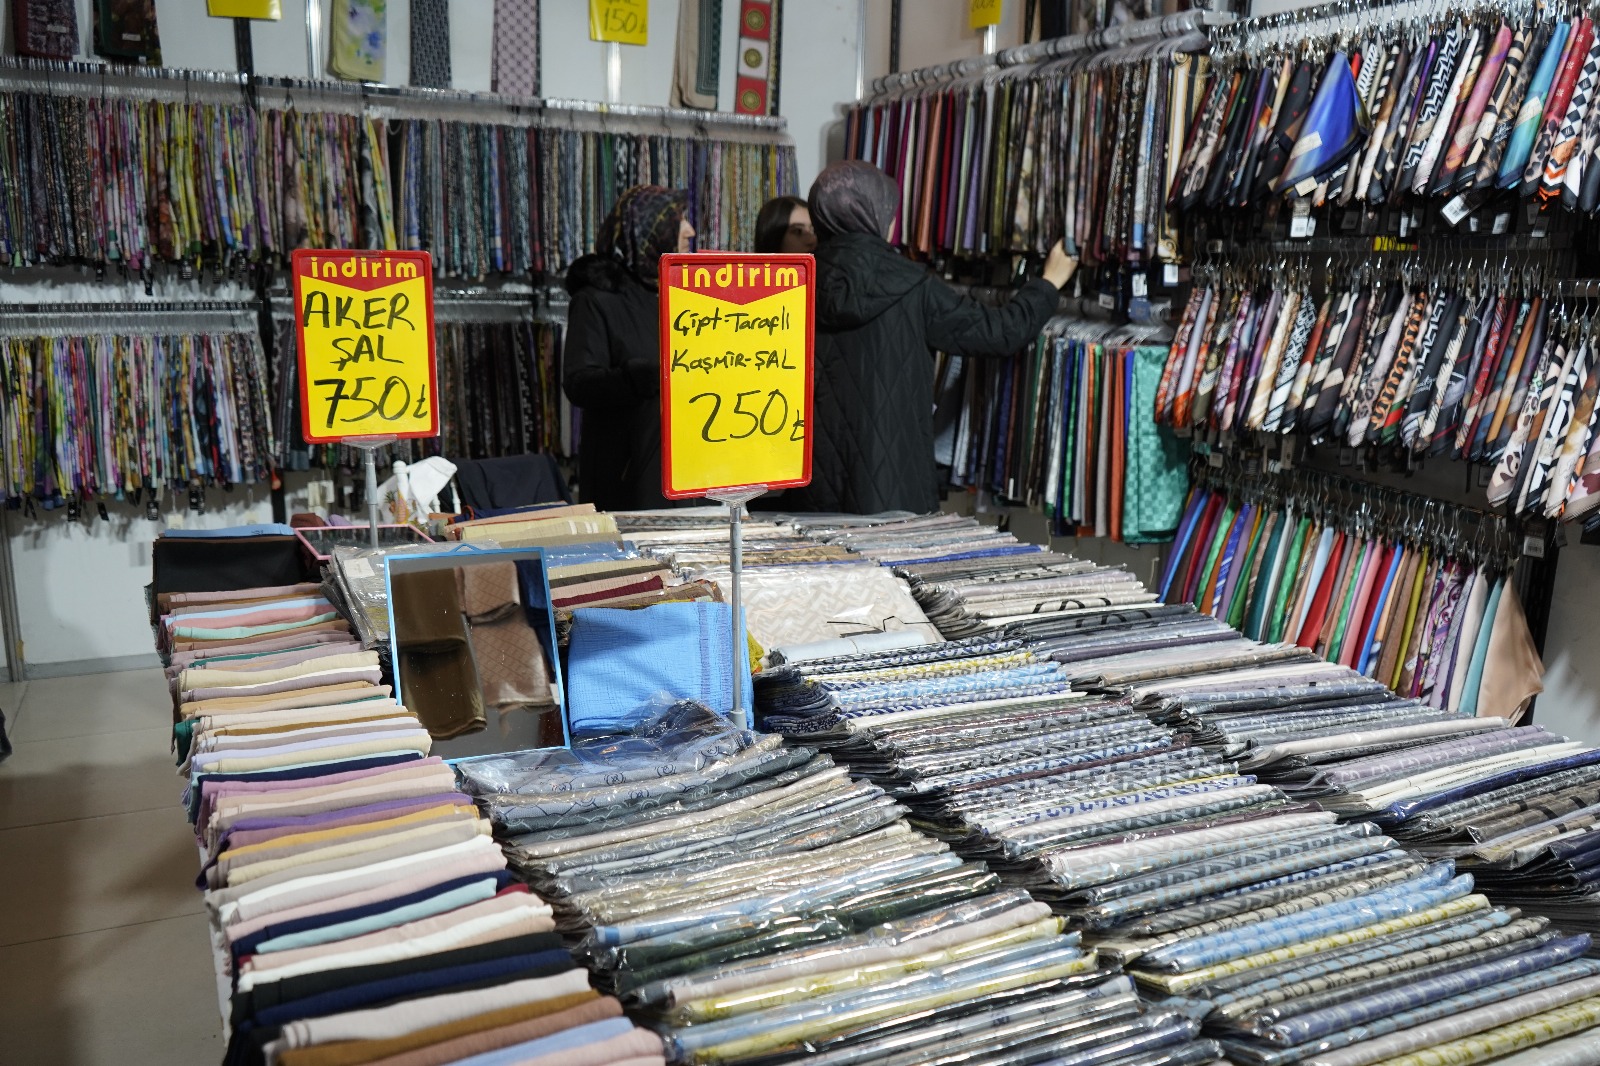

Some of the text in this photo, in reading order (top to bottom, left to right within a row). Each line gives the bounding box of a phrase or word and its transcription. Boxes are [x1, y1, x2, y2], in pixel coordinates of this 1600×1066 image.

[310, 256, 417, 278] indirim
[682, 263, 799, 288] indirim
[303, 290, 416, 331] AKER
[329, 334, 404, 372] ŞAL
